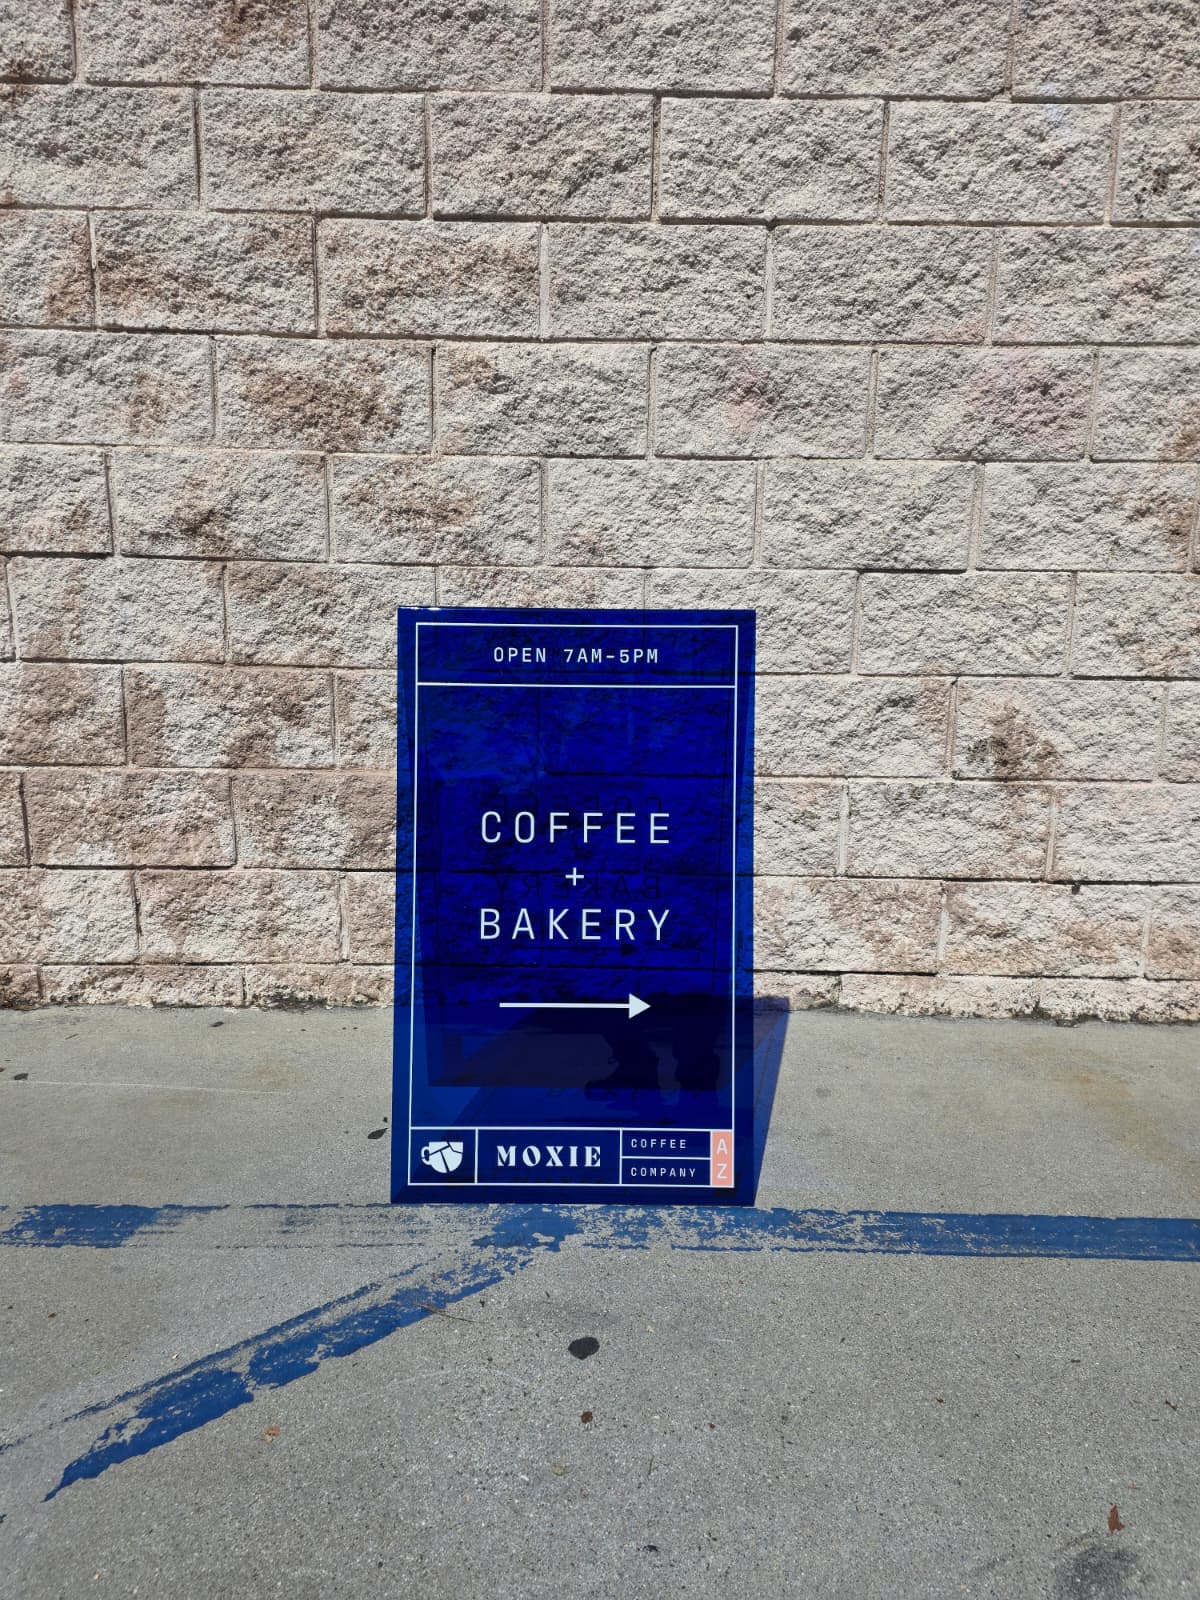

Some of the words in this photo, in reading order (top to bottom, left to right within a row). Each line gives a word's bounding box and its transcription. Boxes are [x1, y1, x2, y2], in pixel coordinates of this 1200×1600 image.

[493, 646, 546, 663] OPEN
[563, 648, 658, 664] 7AM-5PM
[480, 811, 671, 844] COFFEE
[480, 908, 671, 941] BAKERY
[630, 1138, 687, 1149] COFFEE
[496, 1145, 602, 1167] MOXIE
[630, 1167, 697, 1178] COMPANY
